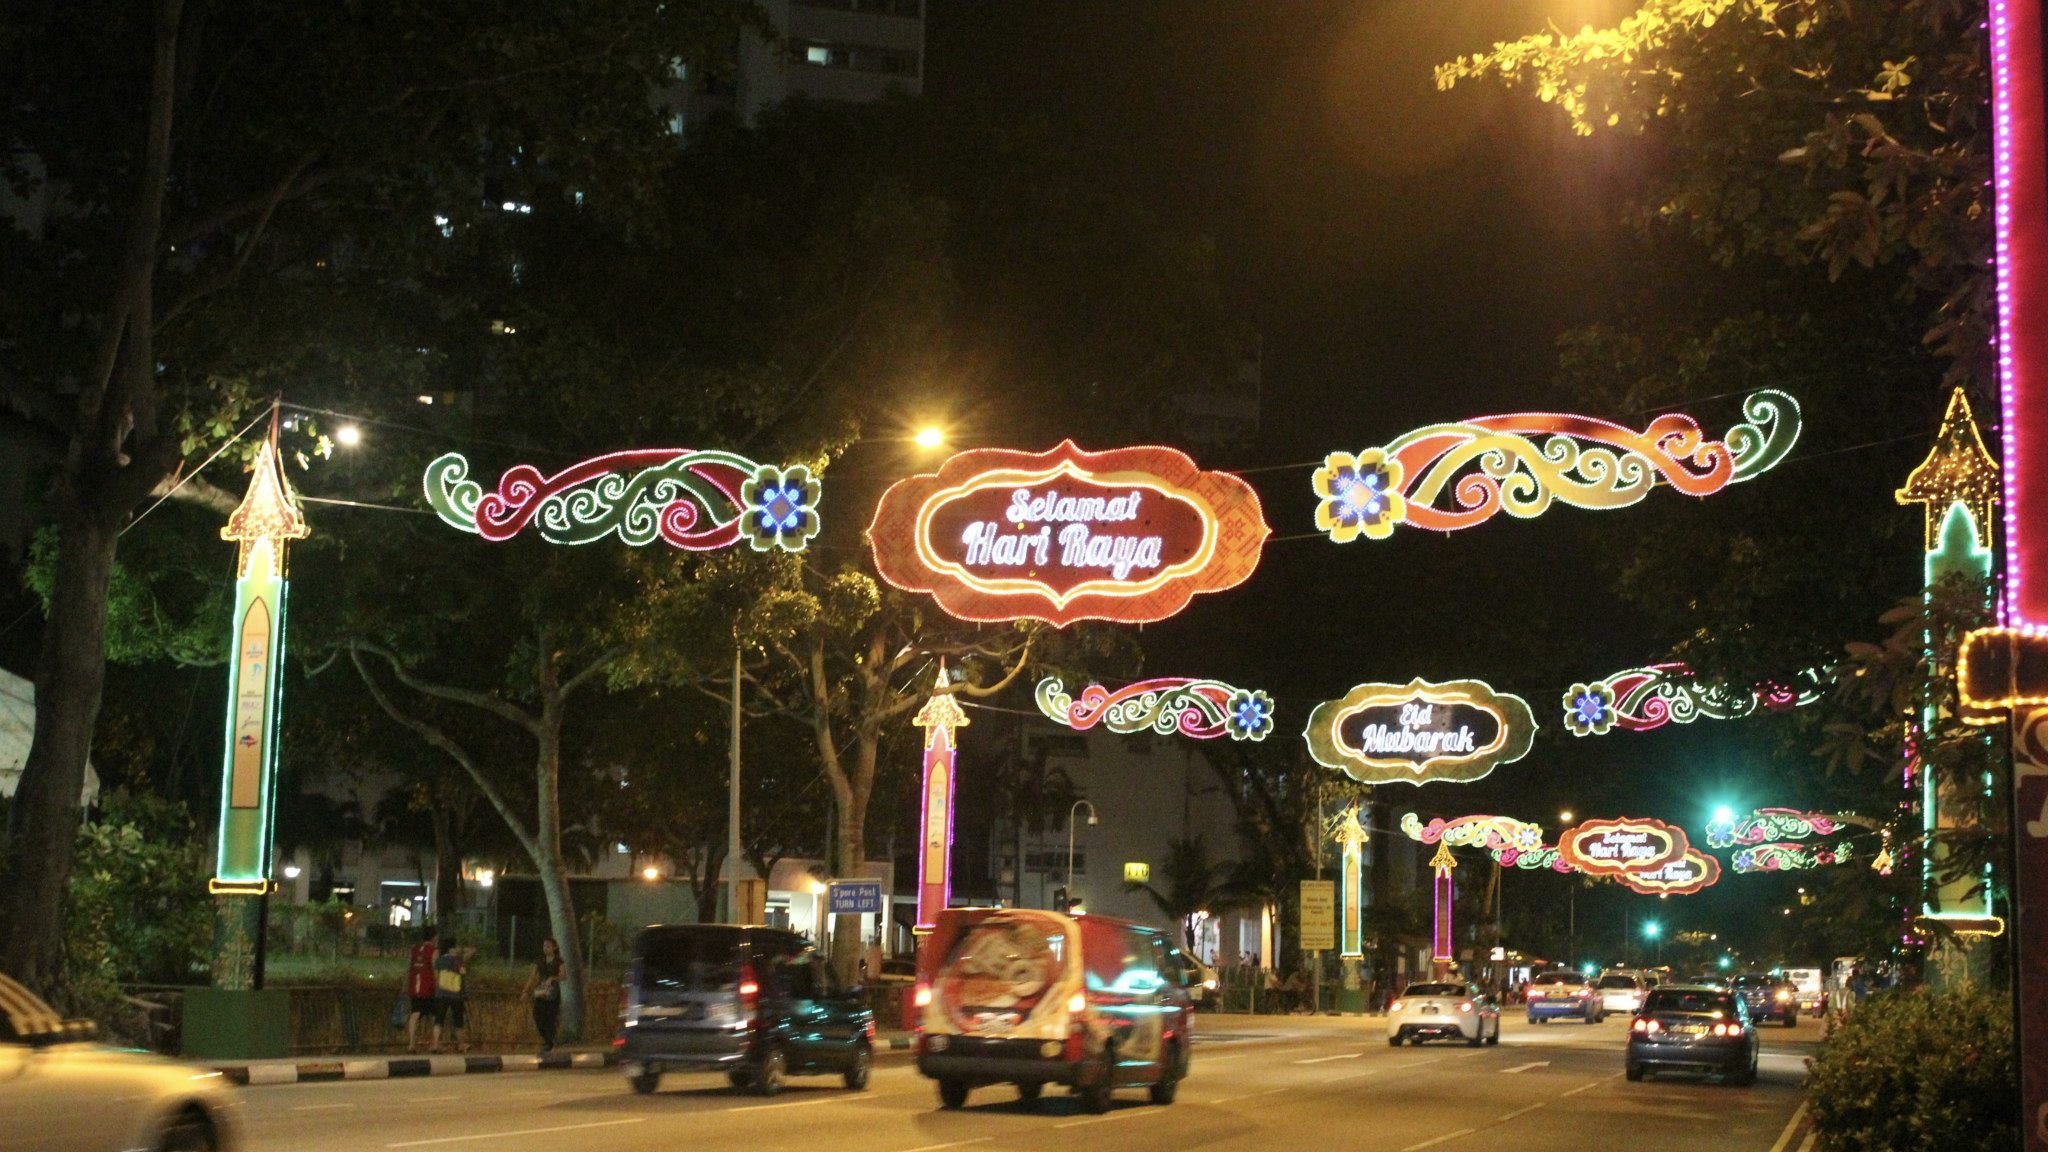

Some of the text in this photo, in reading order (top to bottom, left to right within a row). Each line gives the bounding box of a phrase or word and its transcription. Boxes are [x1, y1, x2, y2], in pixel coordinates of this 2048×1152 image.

[1006, 488, 1143, 523] Selamat
[961, 521, 1163, 580] Hari Raya
[1399, 703, 1433, 726] Eid
[1362, 723, 1476, 753] Mubarak
[835, 898, 874, 909] TURN LEFT
